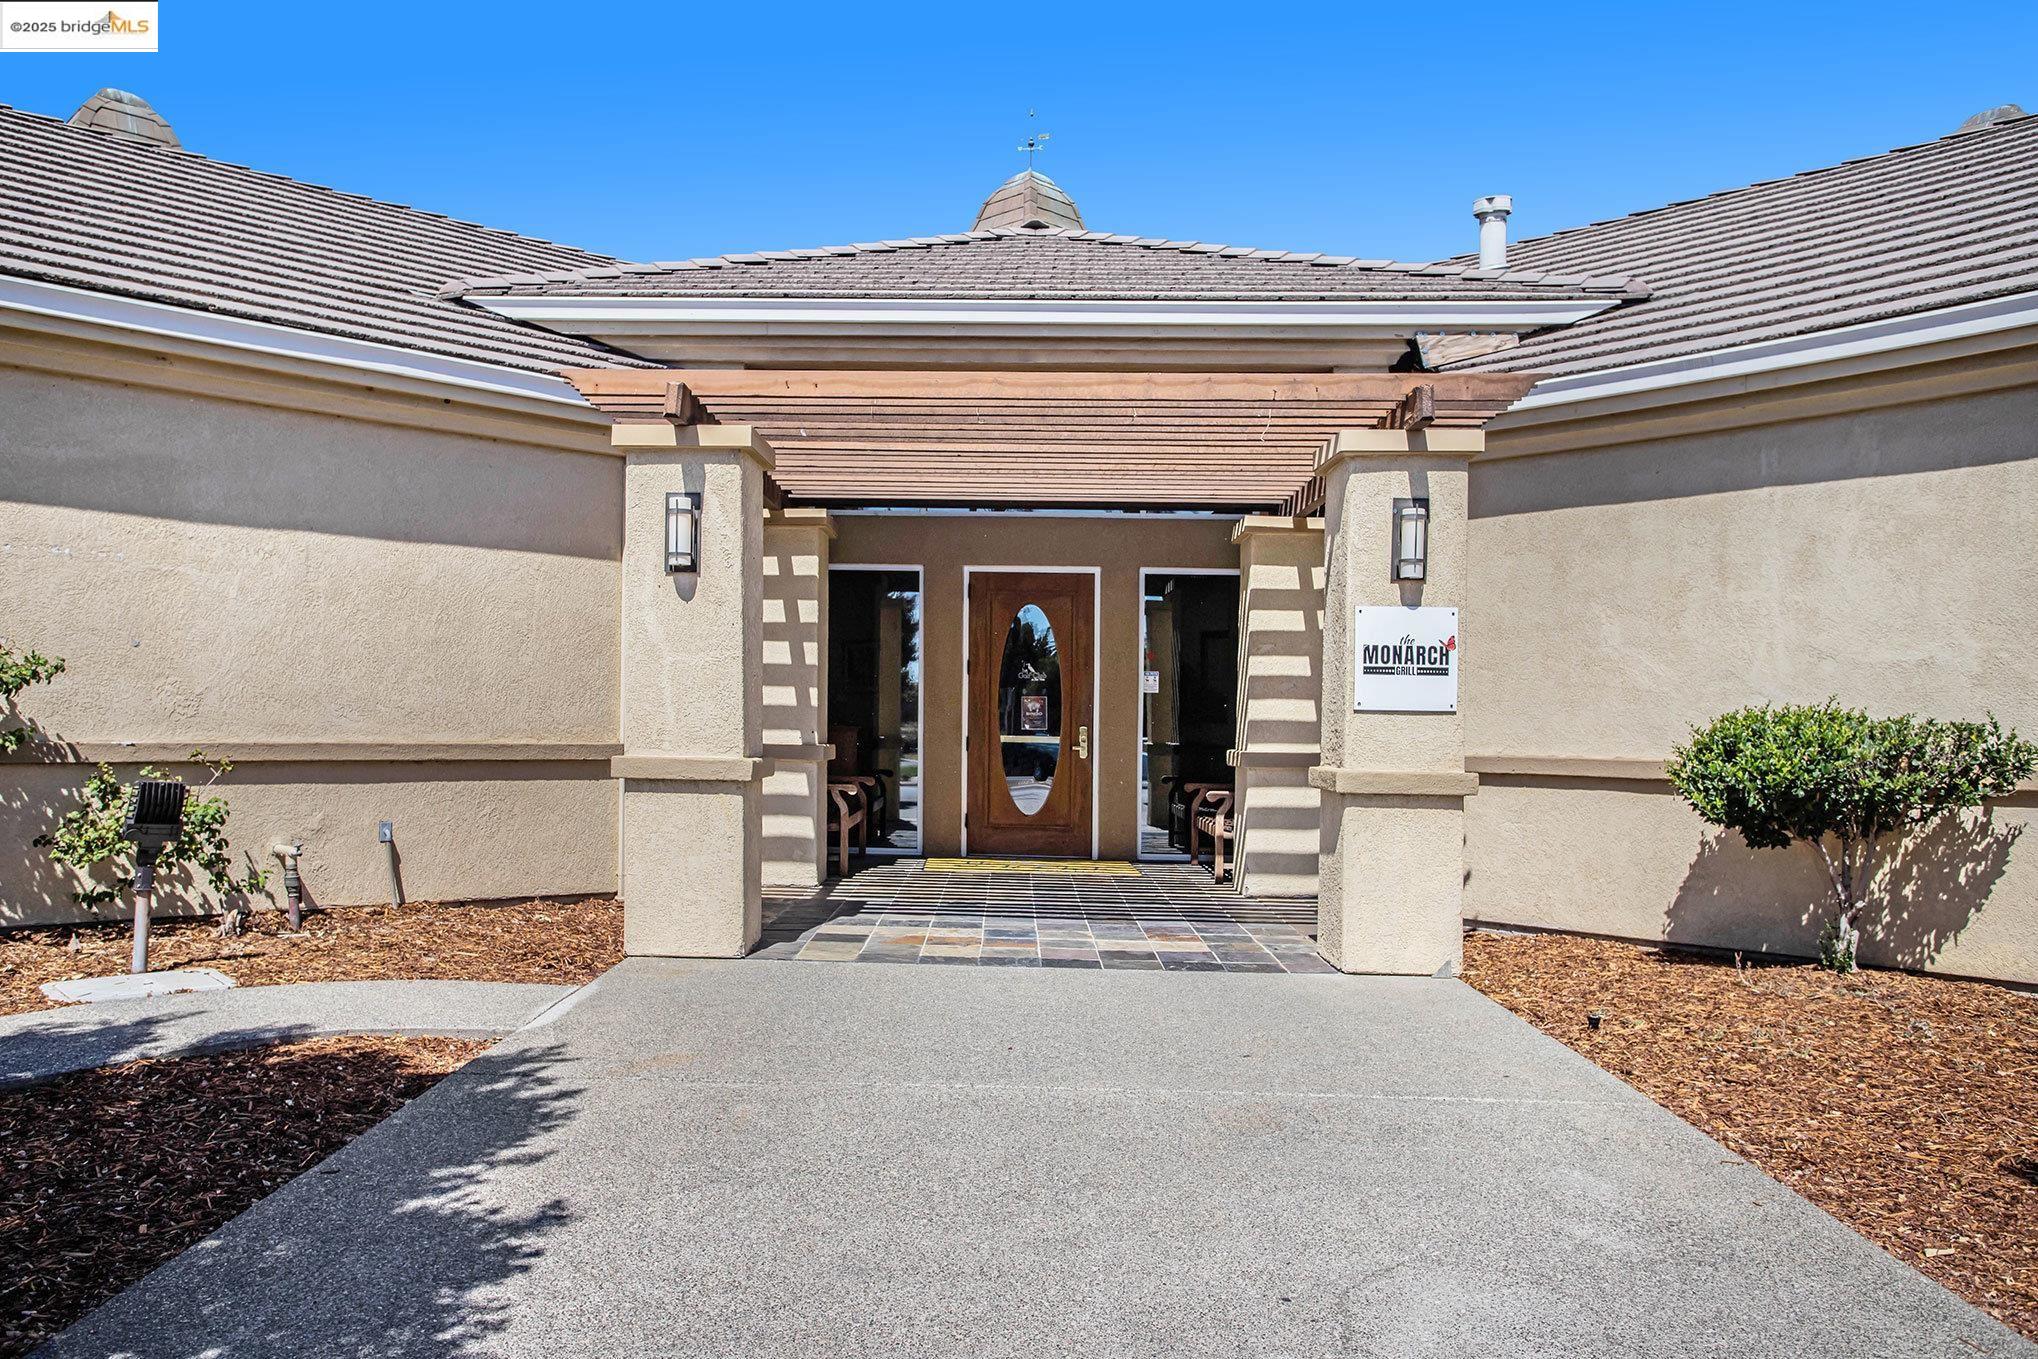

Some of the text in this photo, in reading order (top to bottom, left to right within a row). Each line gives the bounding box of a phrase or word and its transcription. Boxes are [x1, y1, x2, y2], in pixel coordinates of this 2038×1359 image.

[1400, 634, 1415, 645] the
[1363, 644, 1450, 666] MONARCH
[1395, 666, 1416, 676] GRILL
